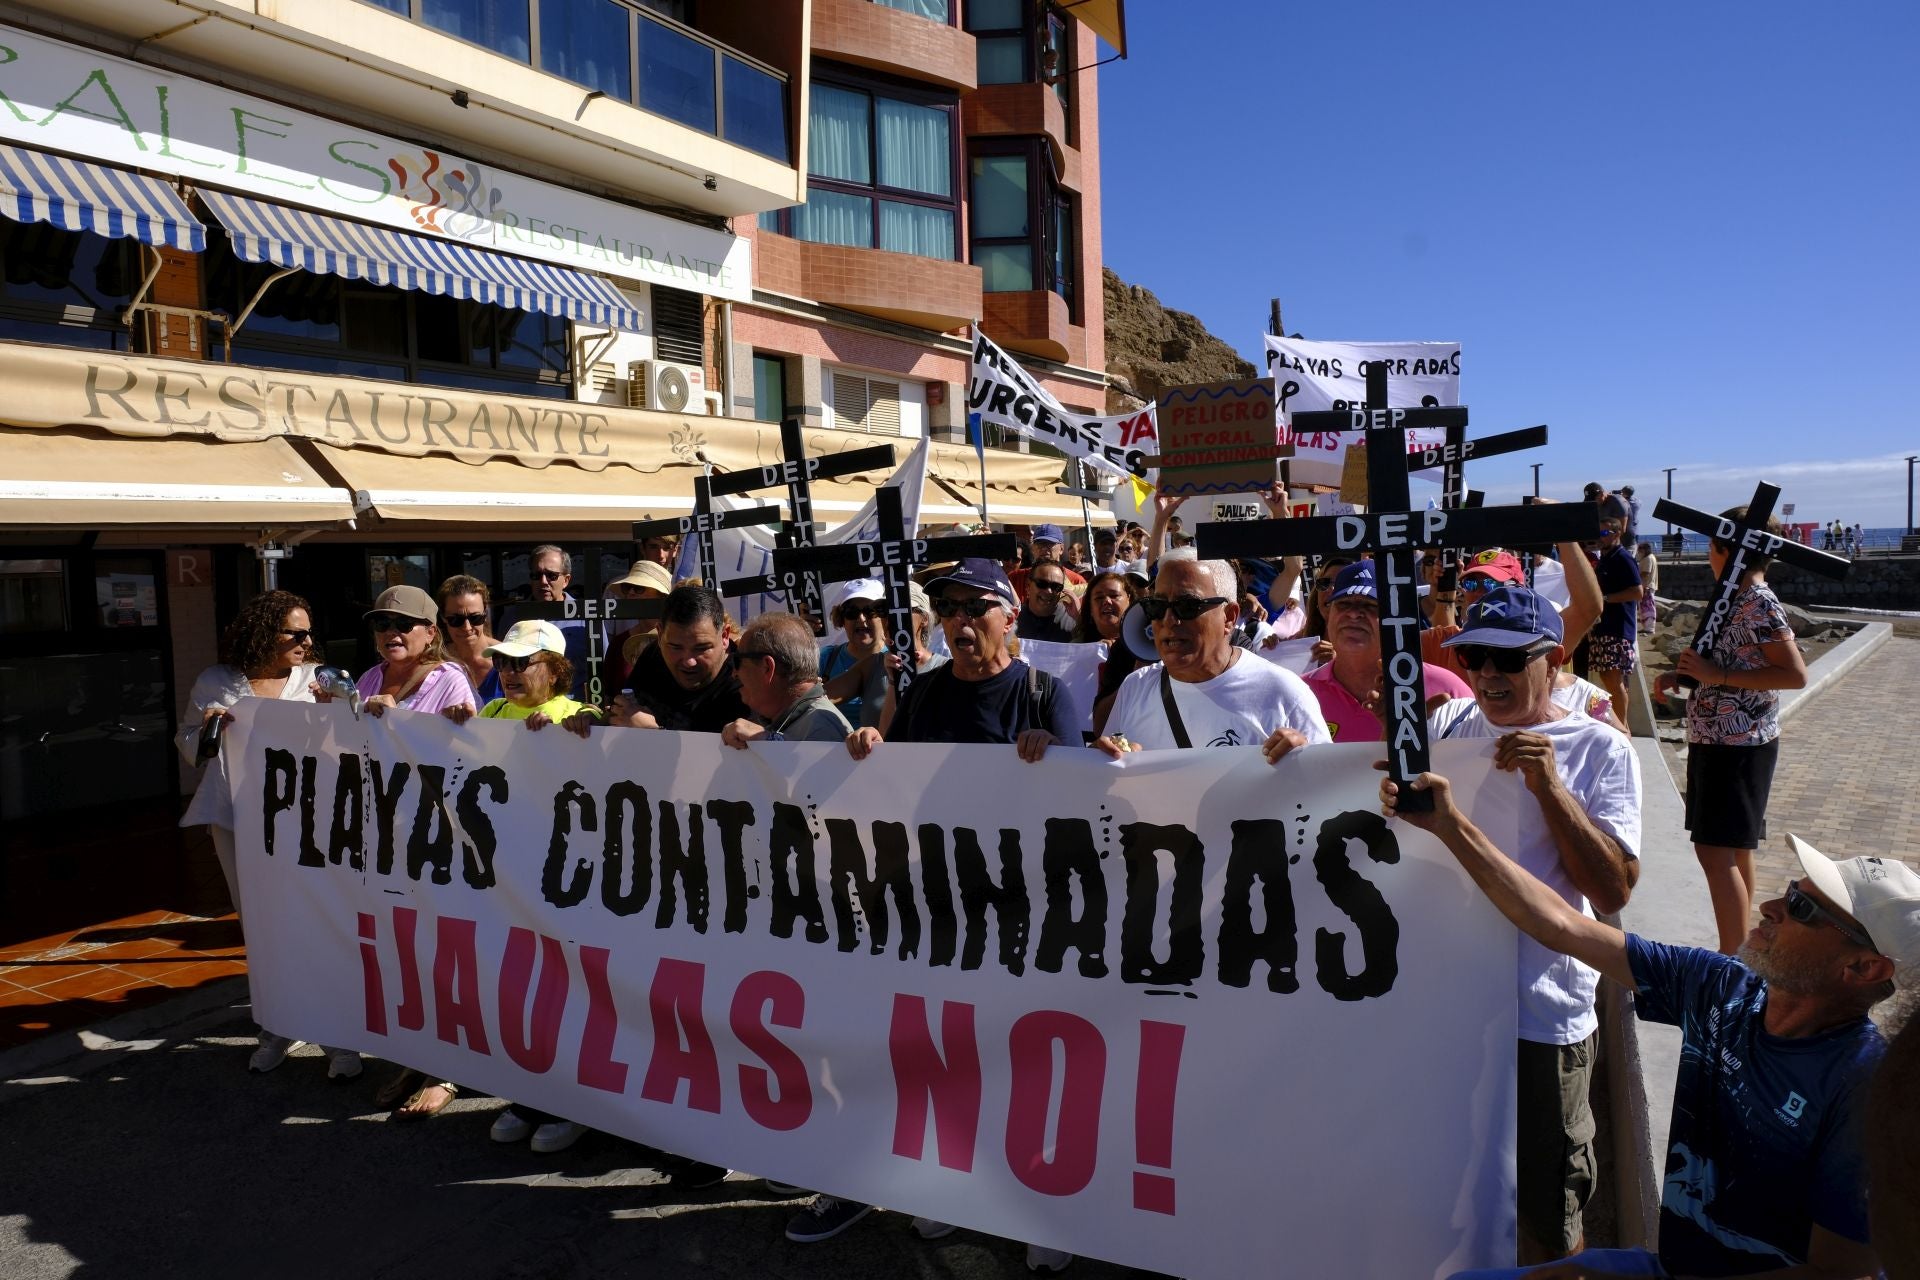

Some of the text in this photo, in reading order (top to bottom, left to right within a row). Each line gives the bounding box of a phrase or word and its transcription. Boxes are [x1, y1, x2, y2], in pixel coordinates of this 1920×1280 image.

[503, 211, 734, 289] RESTAURANTE
[1266, 349, 1461, 379] PLAYAS CRRADAS
[83, 363, 610, 456] RESTAURANTE
[1171, 403, 1270, 426] PELIGRO
[969, 377, 1149, 479] URGENTES
[1118, 411, 1157, 447] YA
[1171, 430, 1255, 448] LITORAL
[1275, 424, 1342, 451] AULAS
[762, 458, 820, 487] D.E.P.
[679, 512, 725, 533] D.E.P.
[1335, 509, 1449, 551] D.E.P.
[1716, 520, 1784, 558] D.E.P.
[178, 555, 201, 583] R
[856, 540, 928, 566] D.E.P.
[564, 598, 618, 619] D.E.P.
[889, 566, 916, 698] LITORA
[1381, 552, 1422, 782] LITORAL
[263, 746, 1401, 1001] PLAYAS CONTAMINADAS
[357, 905, 1187, 1217] ¡JAULAS NO!
